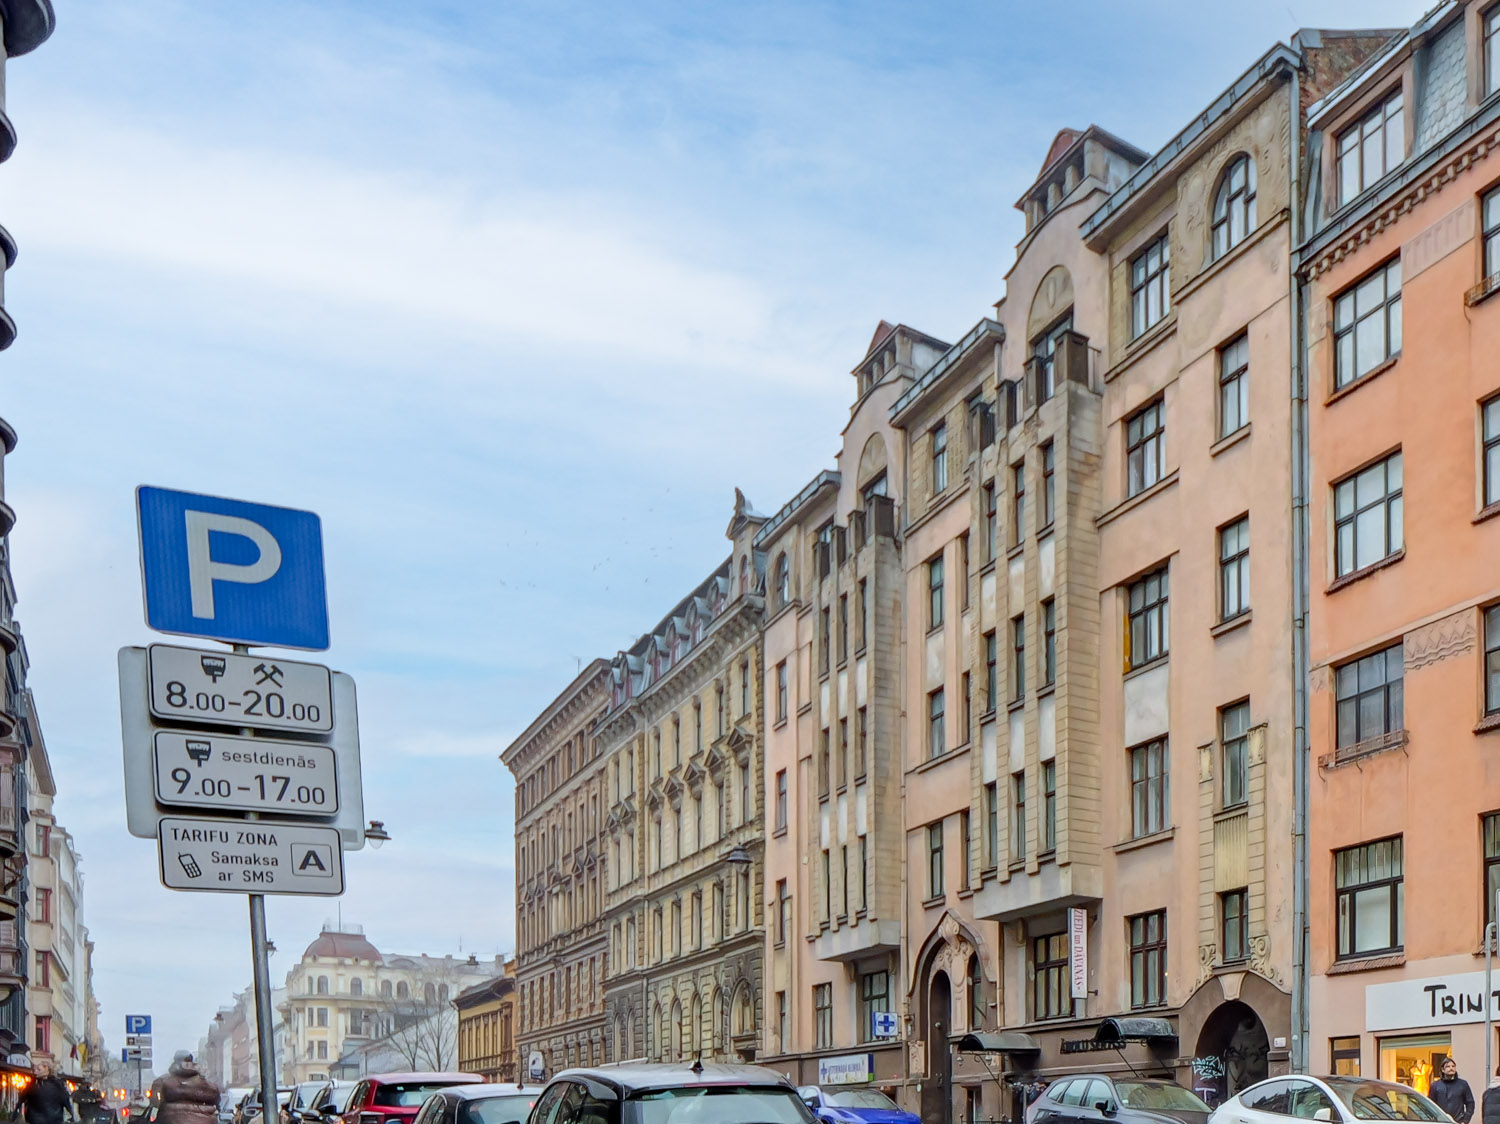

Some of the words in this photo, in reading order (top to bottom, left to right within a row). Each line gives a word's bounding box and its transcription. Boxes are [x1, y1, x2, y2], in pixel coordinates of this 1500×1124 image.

[185, 509, 282, 620] P
[222, 748, 316, 770] sestdienās
[171, 827, 229, 844] TARIFU
[237, 831, 278, 847] ZONA
[211, 851, 279, 868] Samaksa
[299, 850, 327, 872] A
[218, 872, 234, 883] ar
[242, 871, 275, 884] SMS
[131, 1016, 146, 1033] P
